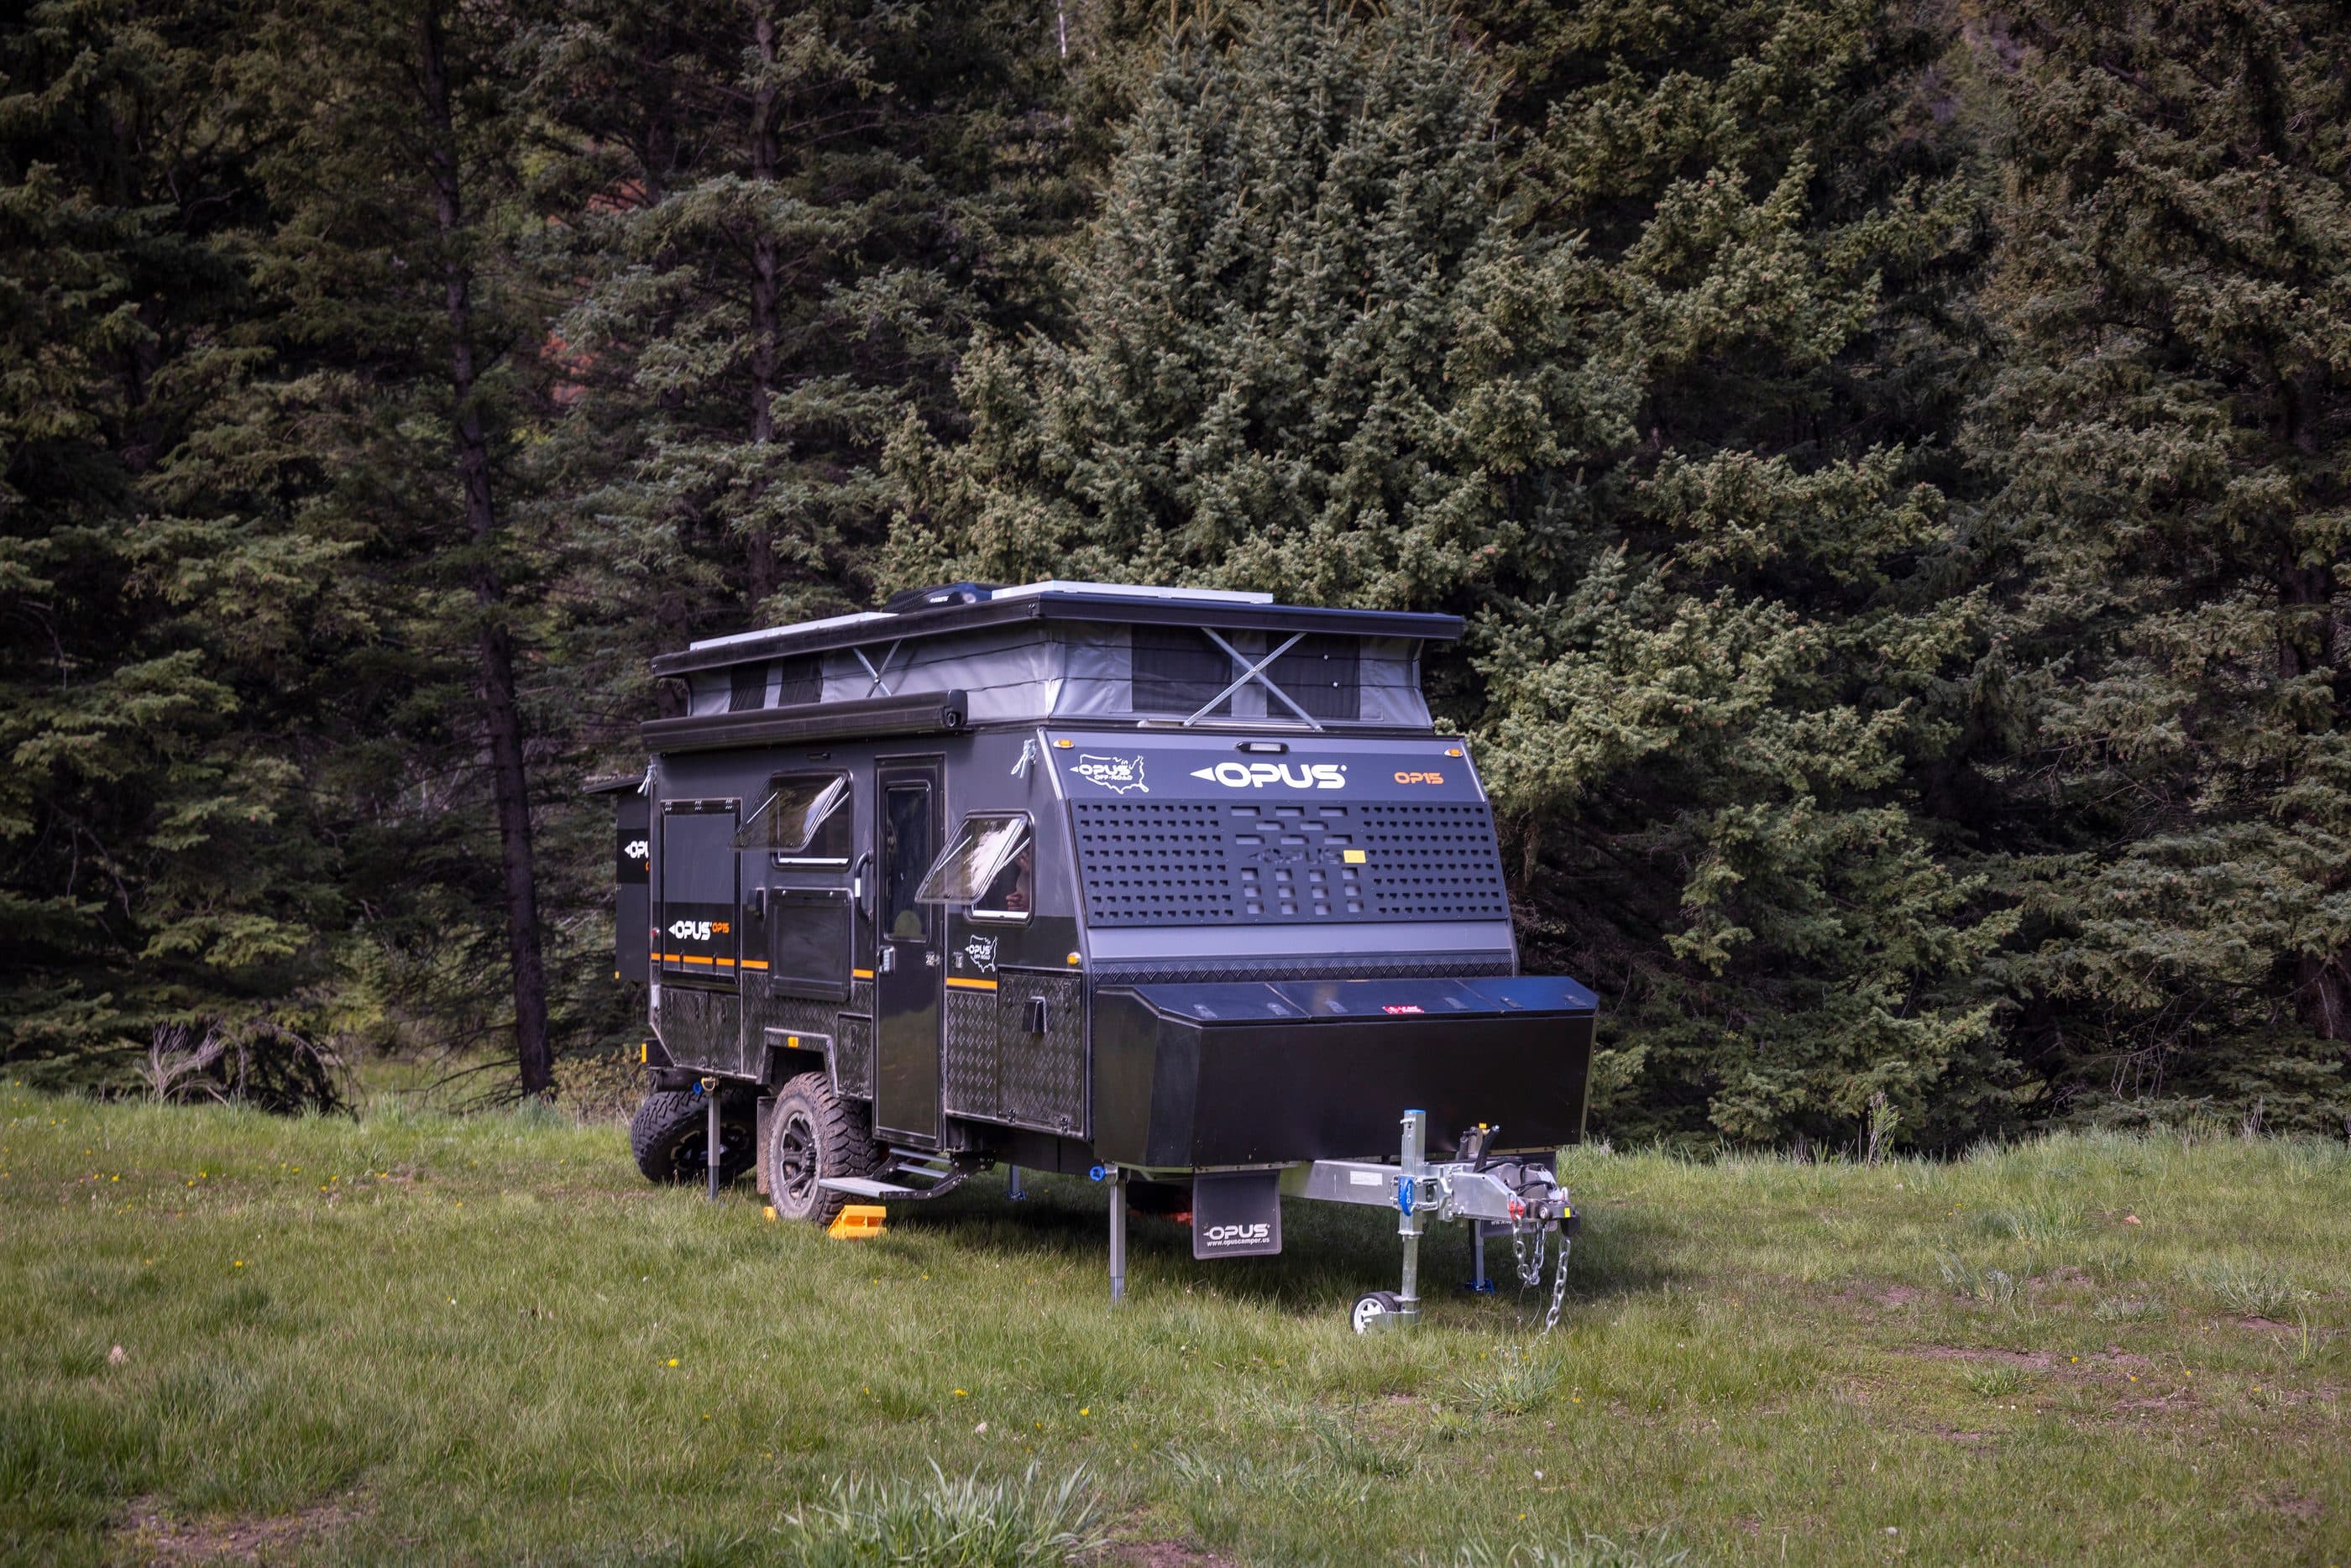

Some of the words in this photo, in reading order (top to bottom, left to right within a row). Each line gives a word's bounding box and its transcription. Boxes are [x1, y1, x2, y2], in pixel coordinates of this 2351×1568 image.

[1079, 765, 1131, 776] OPUS
[1215, 762, 1347, 789] OPUS
[1395, 771, 1444, 785] OP15
[675, 920, 711, 940] OPUS
[712, 922, 730, 933] OP15
[968, 944, 991, 954] OPUS
[1209, 1223, 1270, 1241] OPUS
[1207, 1237, 1270, 1247] www.opuscamper.us
